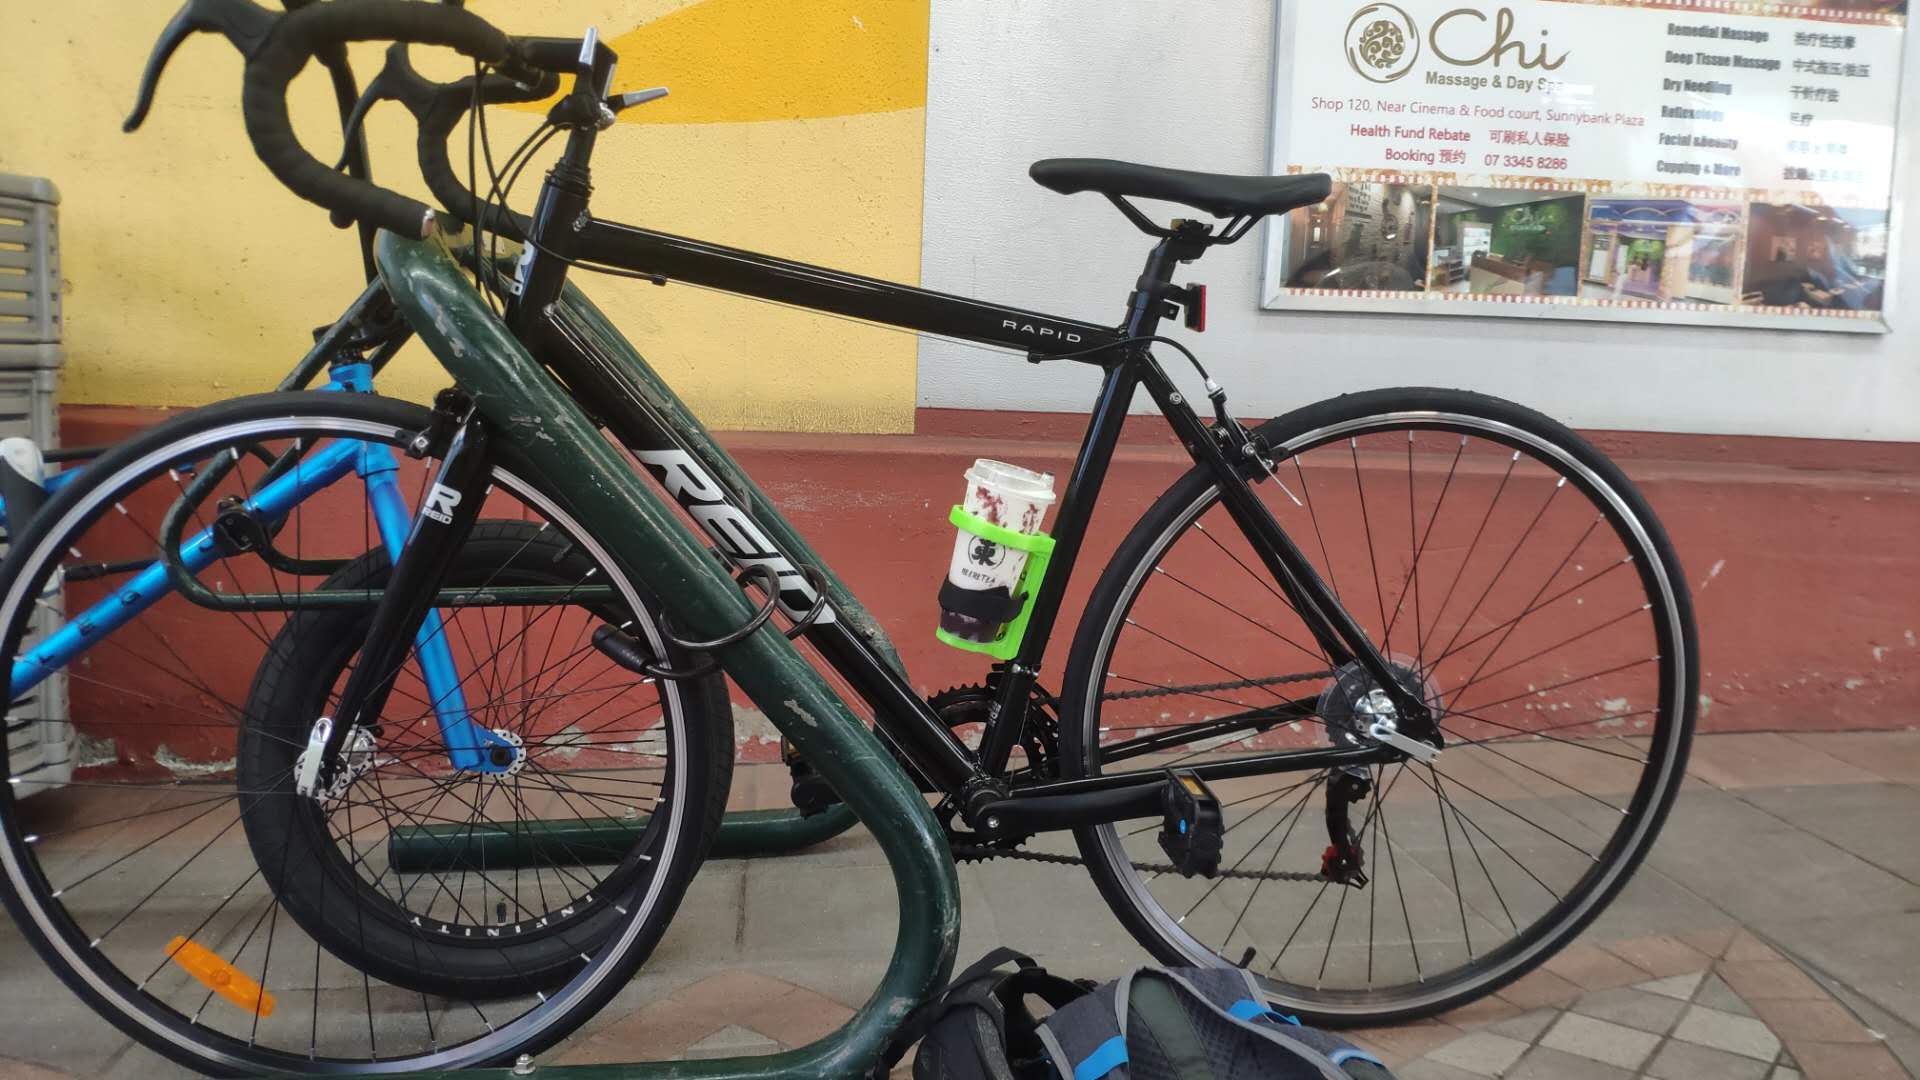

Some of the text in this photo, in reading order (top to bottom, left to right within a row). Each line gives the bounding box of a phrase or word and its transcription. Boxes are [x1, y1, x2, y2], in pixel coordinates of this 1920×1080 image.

[1429, 7, 1571, 70] Chi
[1667, 23, 1769, 43] Remedial Massage
[1665, 50, 1781, 71] Deep Tissue Massage
[1426, 71, 1487, 90] Massage
[1492, 74, 1501, 88] &
[1507, 76, 1533, 92] Day
[1663, 78, 1682, 92] Dry
[1312, 97, 1646, 126] Shop 120, Near Cinema & Food court, Sunnybank Plaza
[1350, 124, 1471, 142] Health Fund Rebate
[1489, 129, 1570, 147] 可刷私人保险
[1659, 132, 1692, 146] Facial
[1385, 148, 1466, 165] Booking 预约
[1484, 154, 1568, 170] 07 3345 8286
[1002, 320, 1081, 343] RAPID
[410, 894, 593, 937] INFINITY
